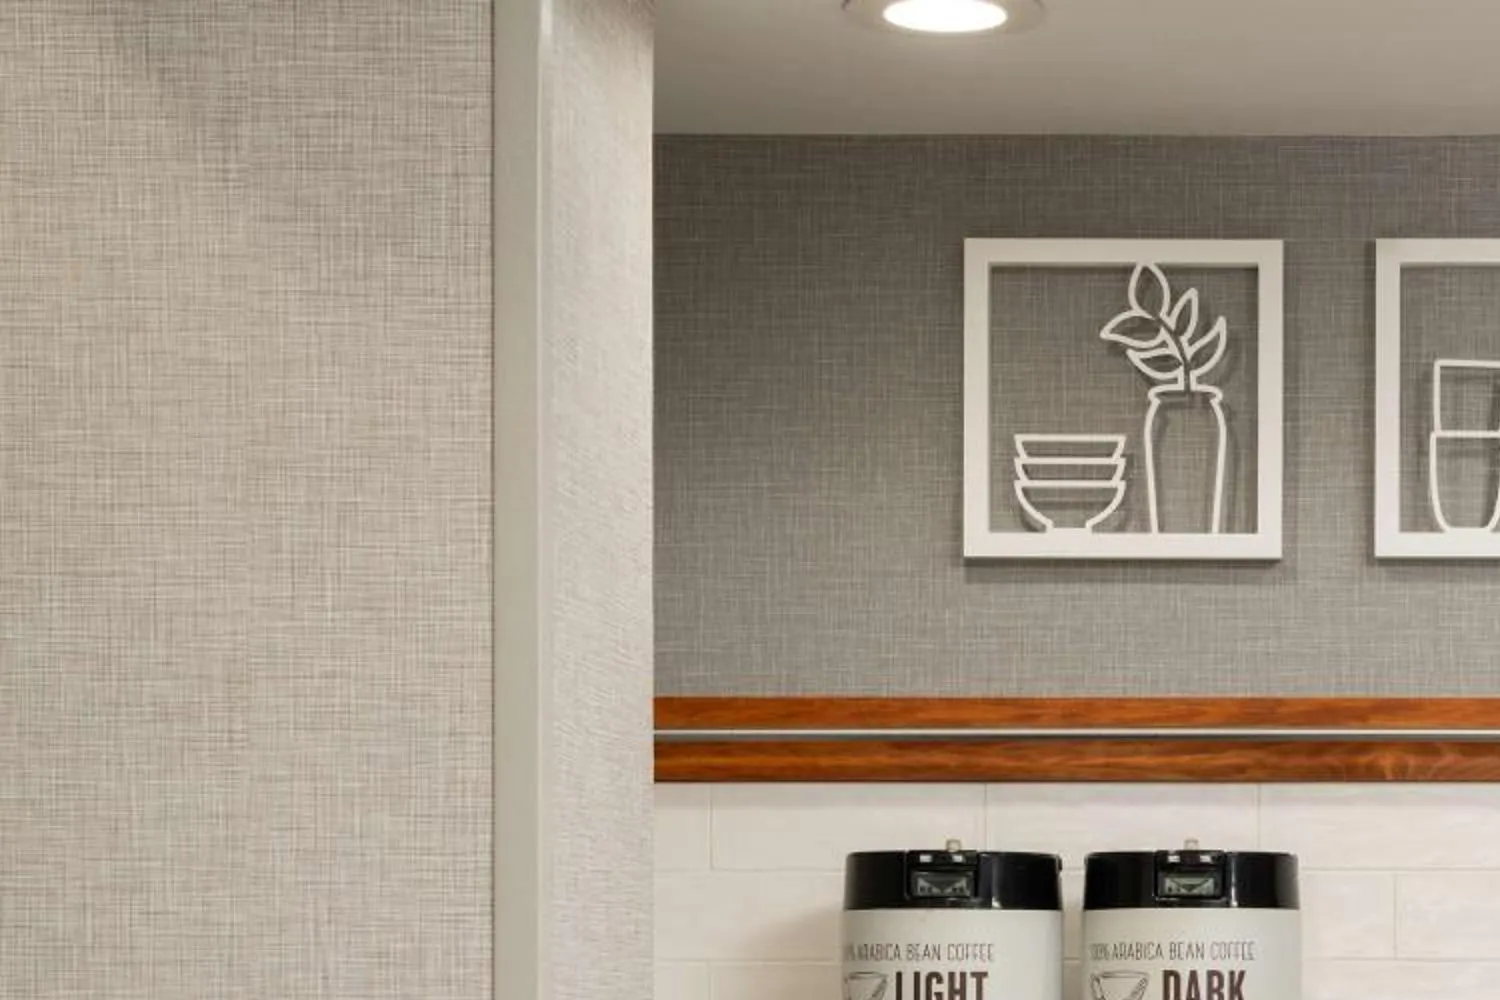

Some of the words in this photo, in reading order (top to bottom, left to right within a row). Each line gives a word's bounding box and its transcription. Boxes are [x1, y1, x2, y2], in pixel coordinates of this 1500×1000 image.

[906, 943, 941, 961] BEAN
[947, 943, 995, 961] COFFEE
[1112, 942, 1164, 961] ARABICA
[1169, 942, 1205, 961] BEAN
[1210, 942, 1256, 961] COFFEE
